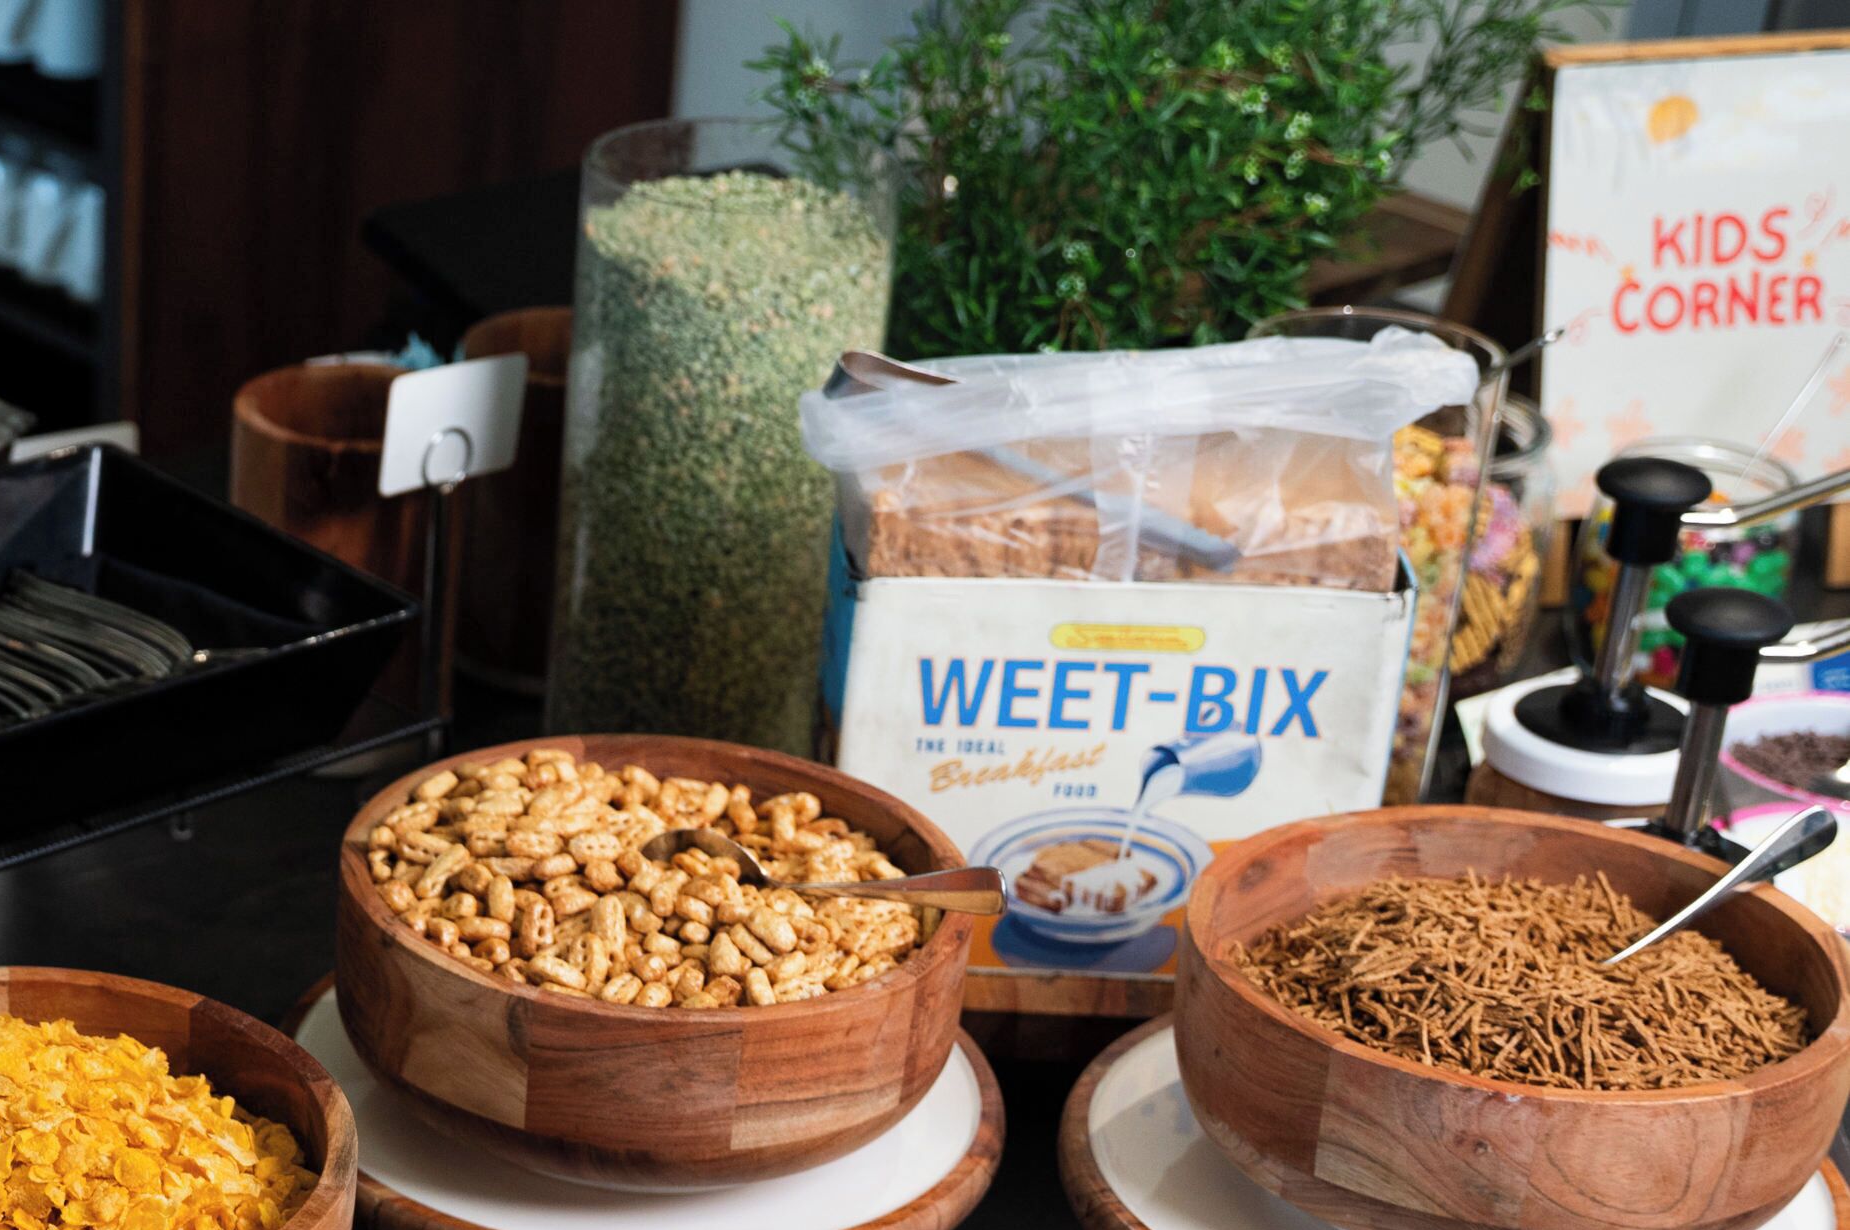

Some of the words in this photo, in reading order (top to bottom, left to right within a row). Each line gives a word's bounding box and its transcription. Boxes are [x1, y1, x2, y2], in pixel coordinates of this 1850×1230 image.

[1651, 207, 1790, 267] KIDS
[1612, 271, 1824, 334] CORNER
[917, 656, 1331, 739] WEET-BIX
[916, 738, 945, 753] THE
[956, 739, 1005, 755] IDEAL
[929, 741, 1106, 794] Breakfast
[1052, 783, 1097, 797] FOOD
